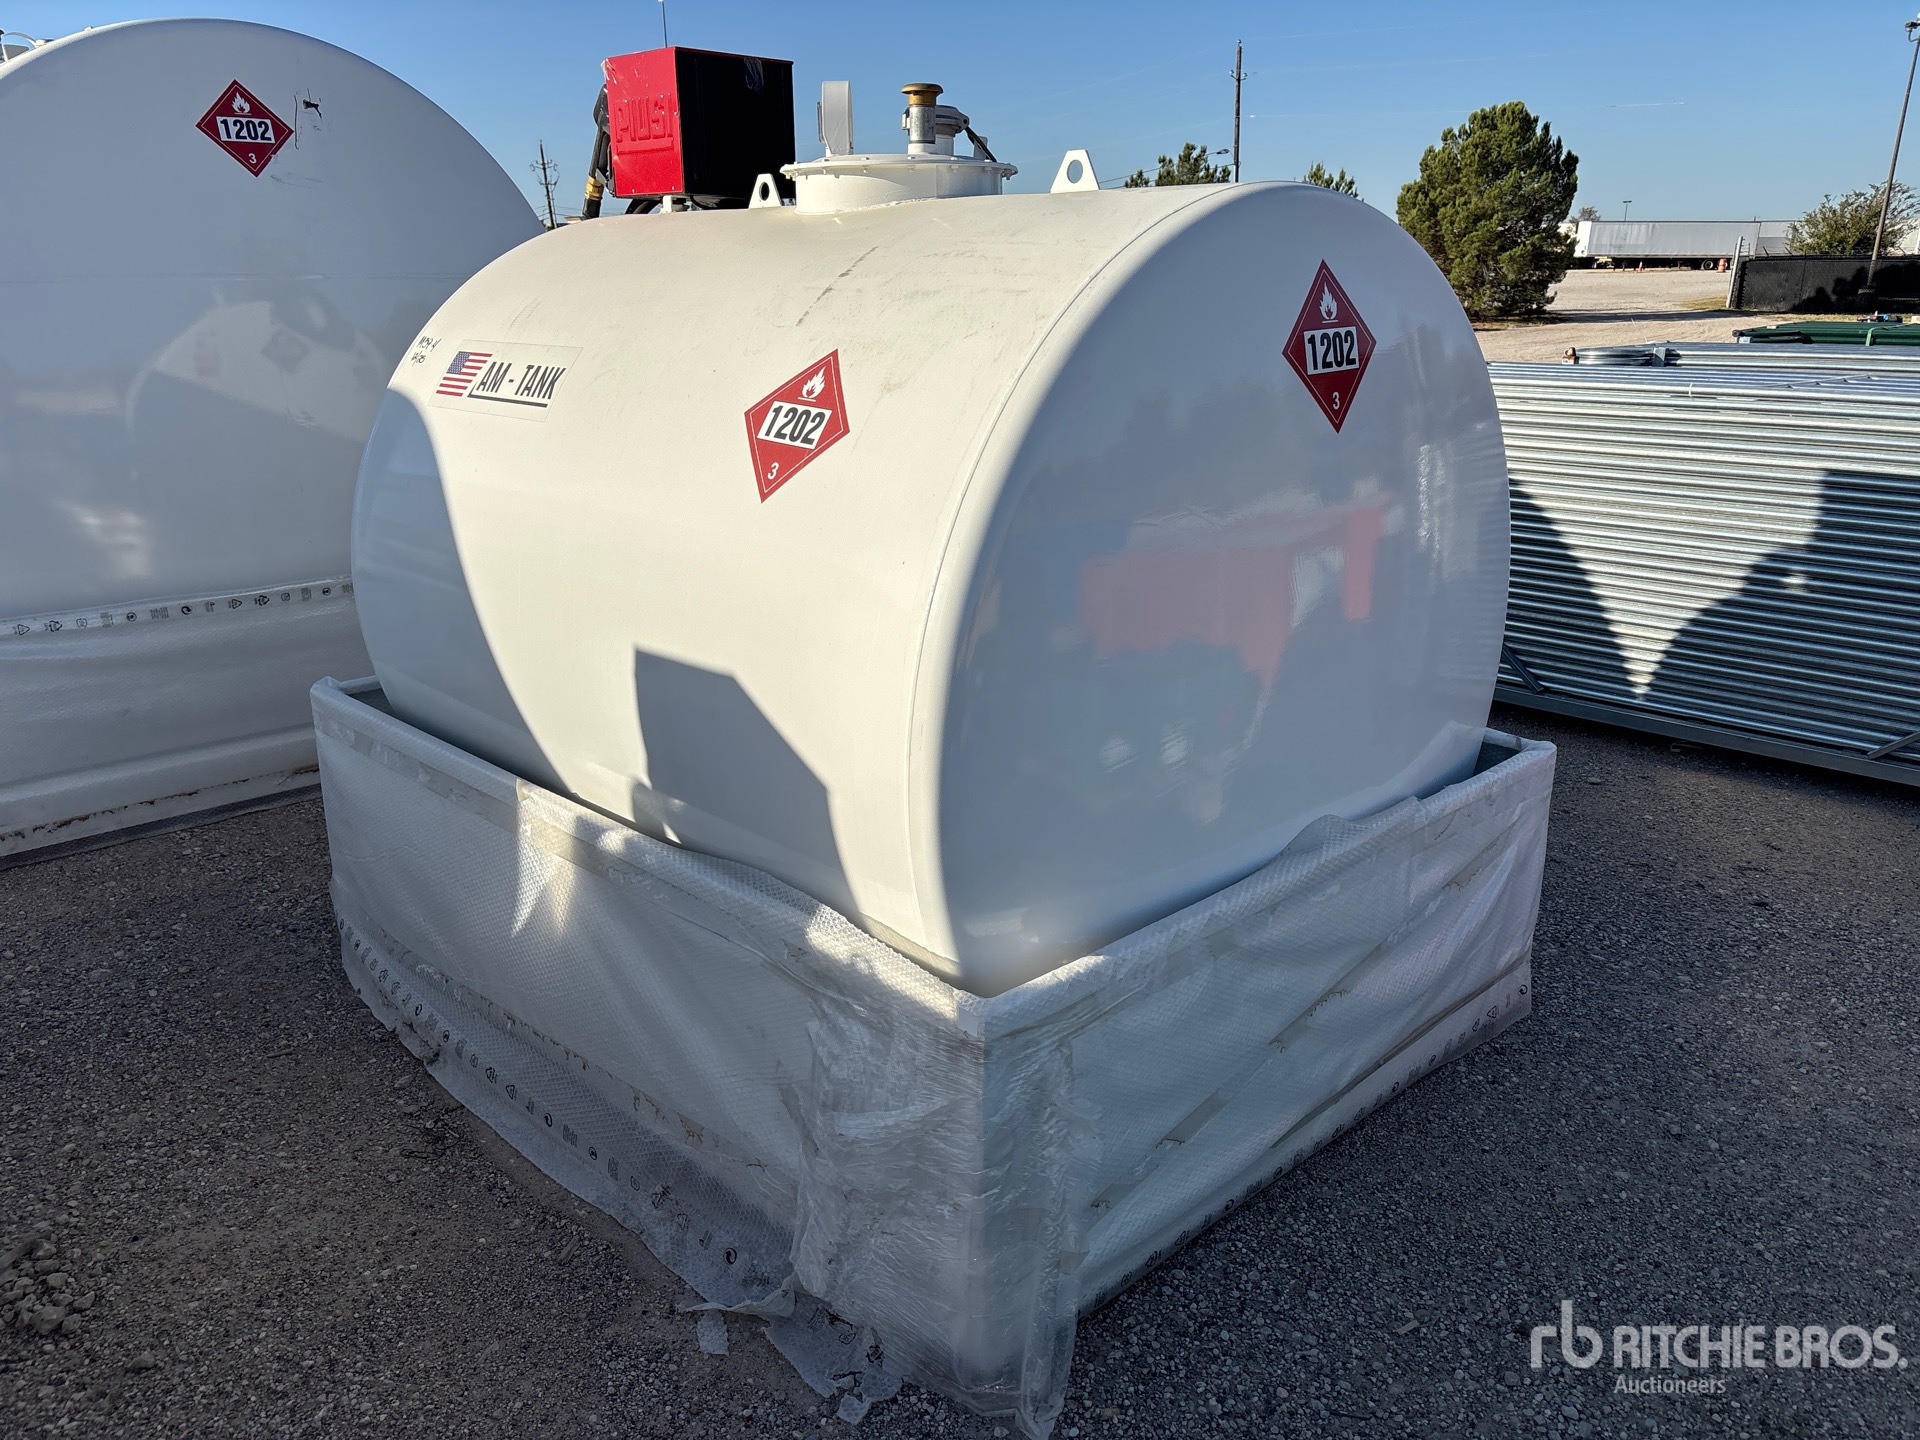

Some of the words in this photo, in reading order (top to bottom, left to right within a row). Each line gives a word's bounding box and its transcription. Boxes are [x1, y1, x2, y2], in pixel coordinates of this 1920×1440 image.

[220, 119, 272, 141] 1202
[248, 153, 257, 164] 3
[1307, 330, 1357, 371] 1202
[476, 362, 512, 393] AM
[514, 365, 567, 400] TANK
[1332, 391, 1340, 410] 3
[764, 405, 826, 446] 1202
[767, 462, 779, 480] 3
